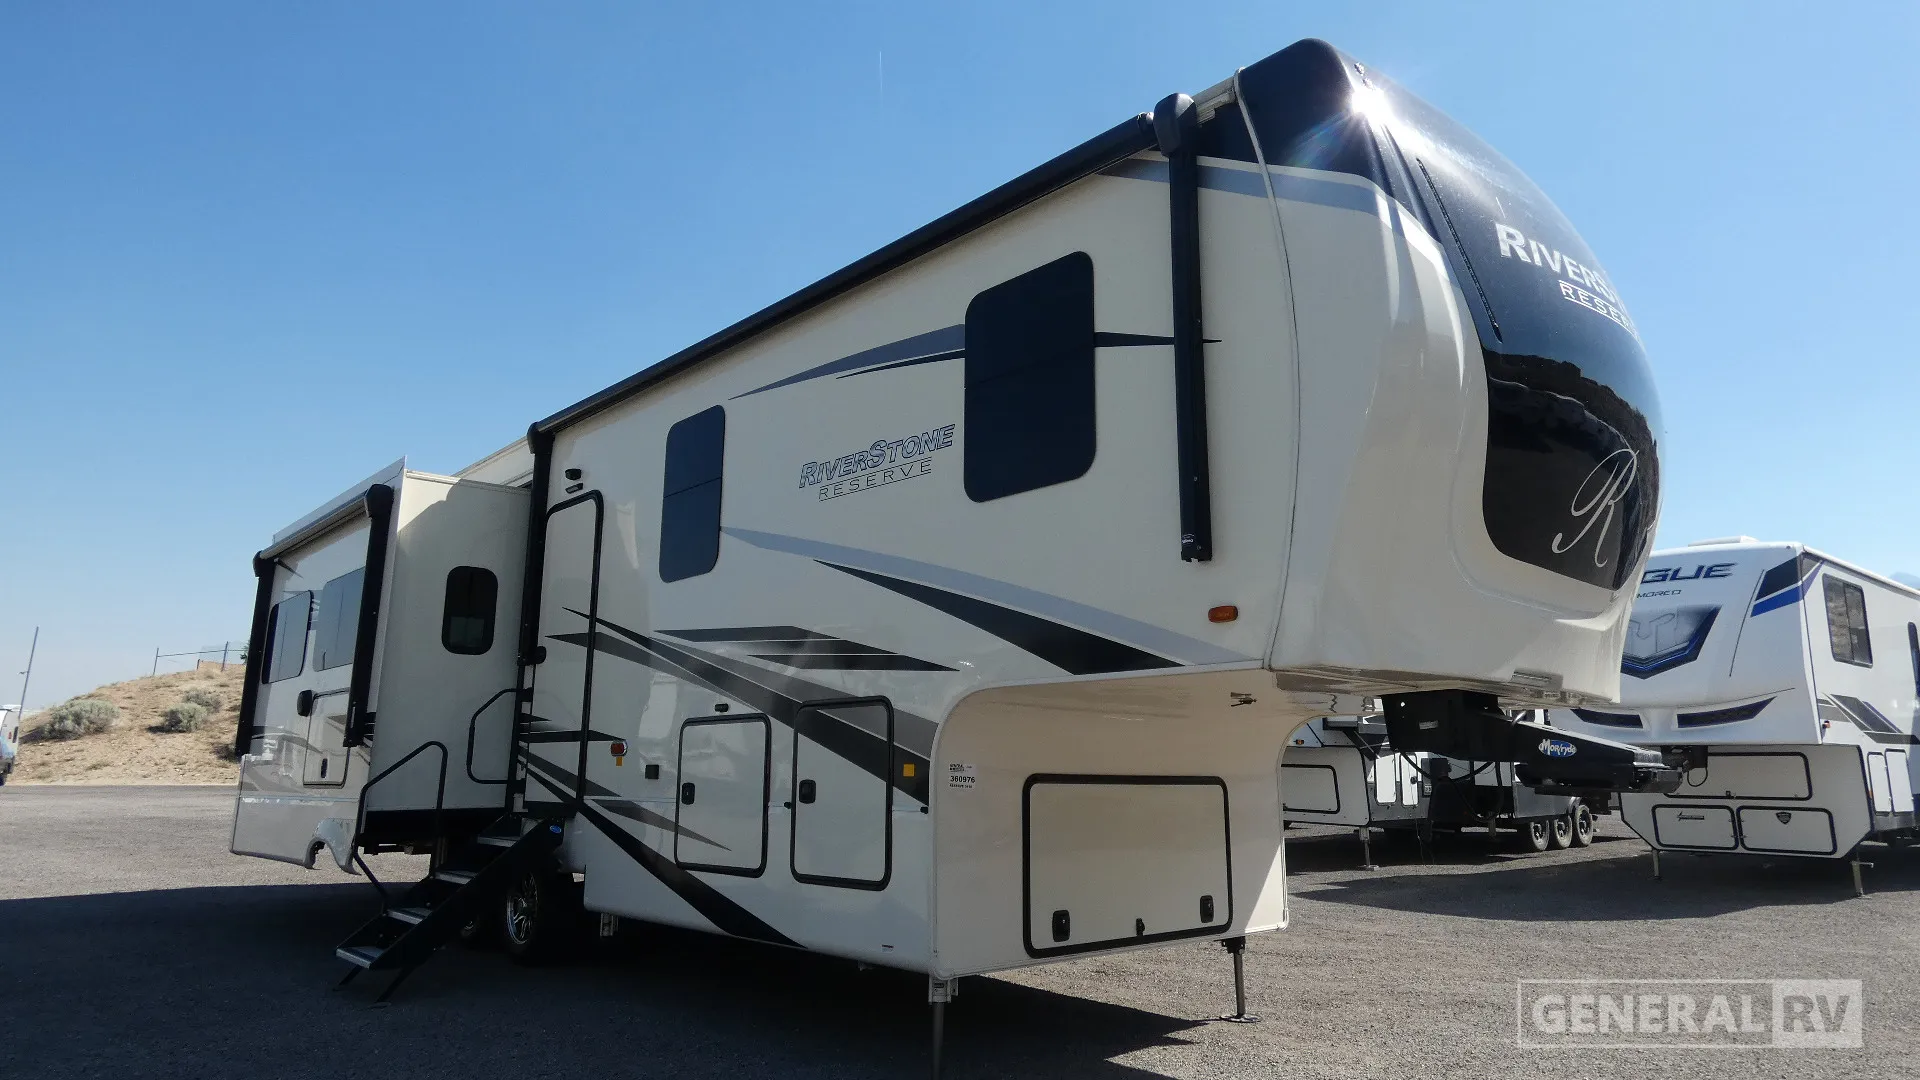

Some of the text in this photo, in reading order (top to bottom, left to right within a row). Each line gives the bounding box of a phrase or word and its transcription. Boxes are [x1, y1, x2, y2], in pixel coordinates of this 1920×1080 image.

[1496, 223, 1620, 304] RIVERS
[1560, 282, 1633, 333] RESER
[799, 424, 955, 488] RIVERSTONE
[818, 461, 932, 499] RESERVE
